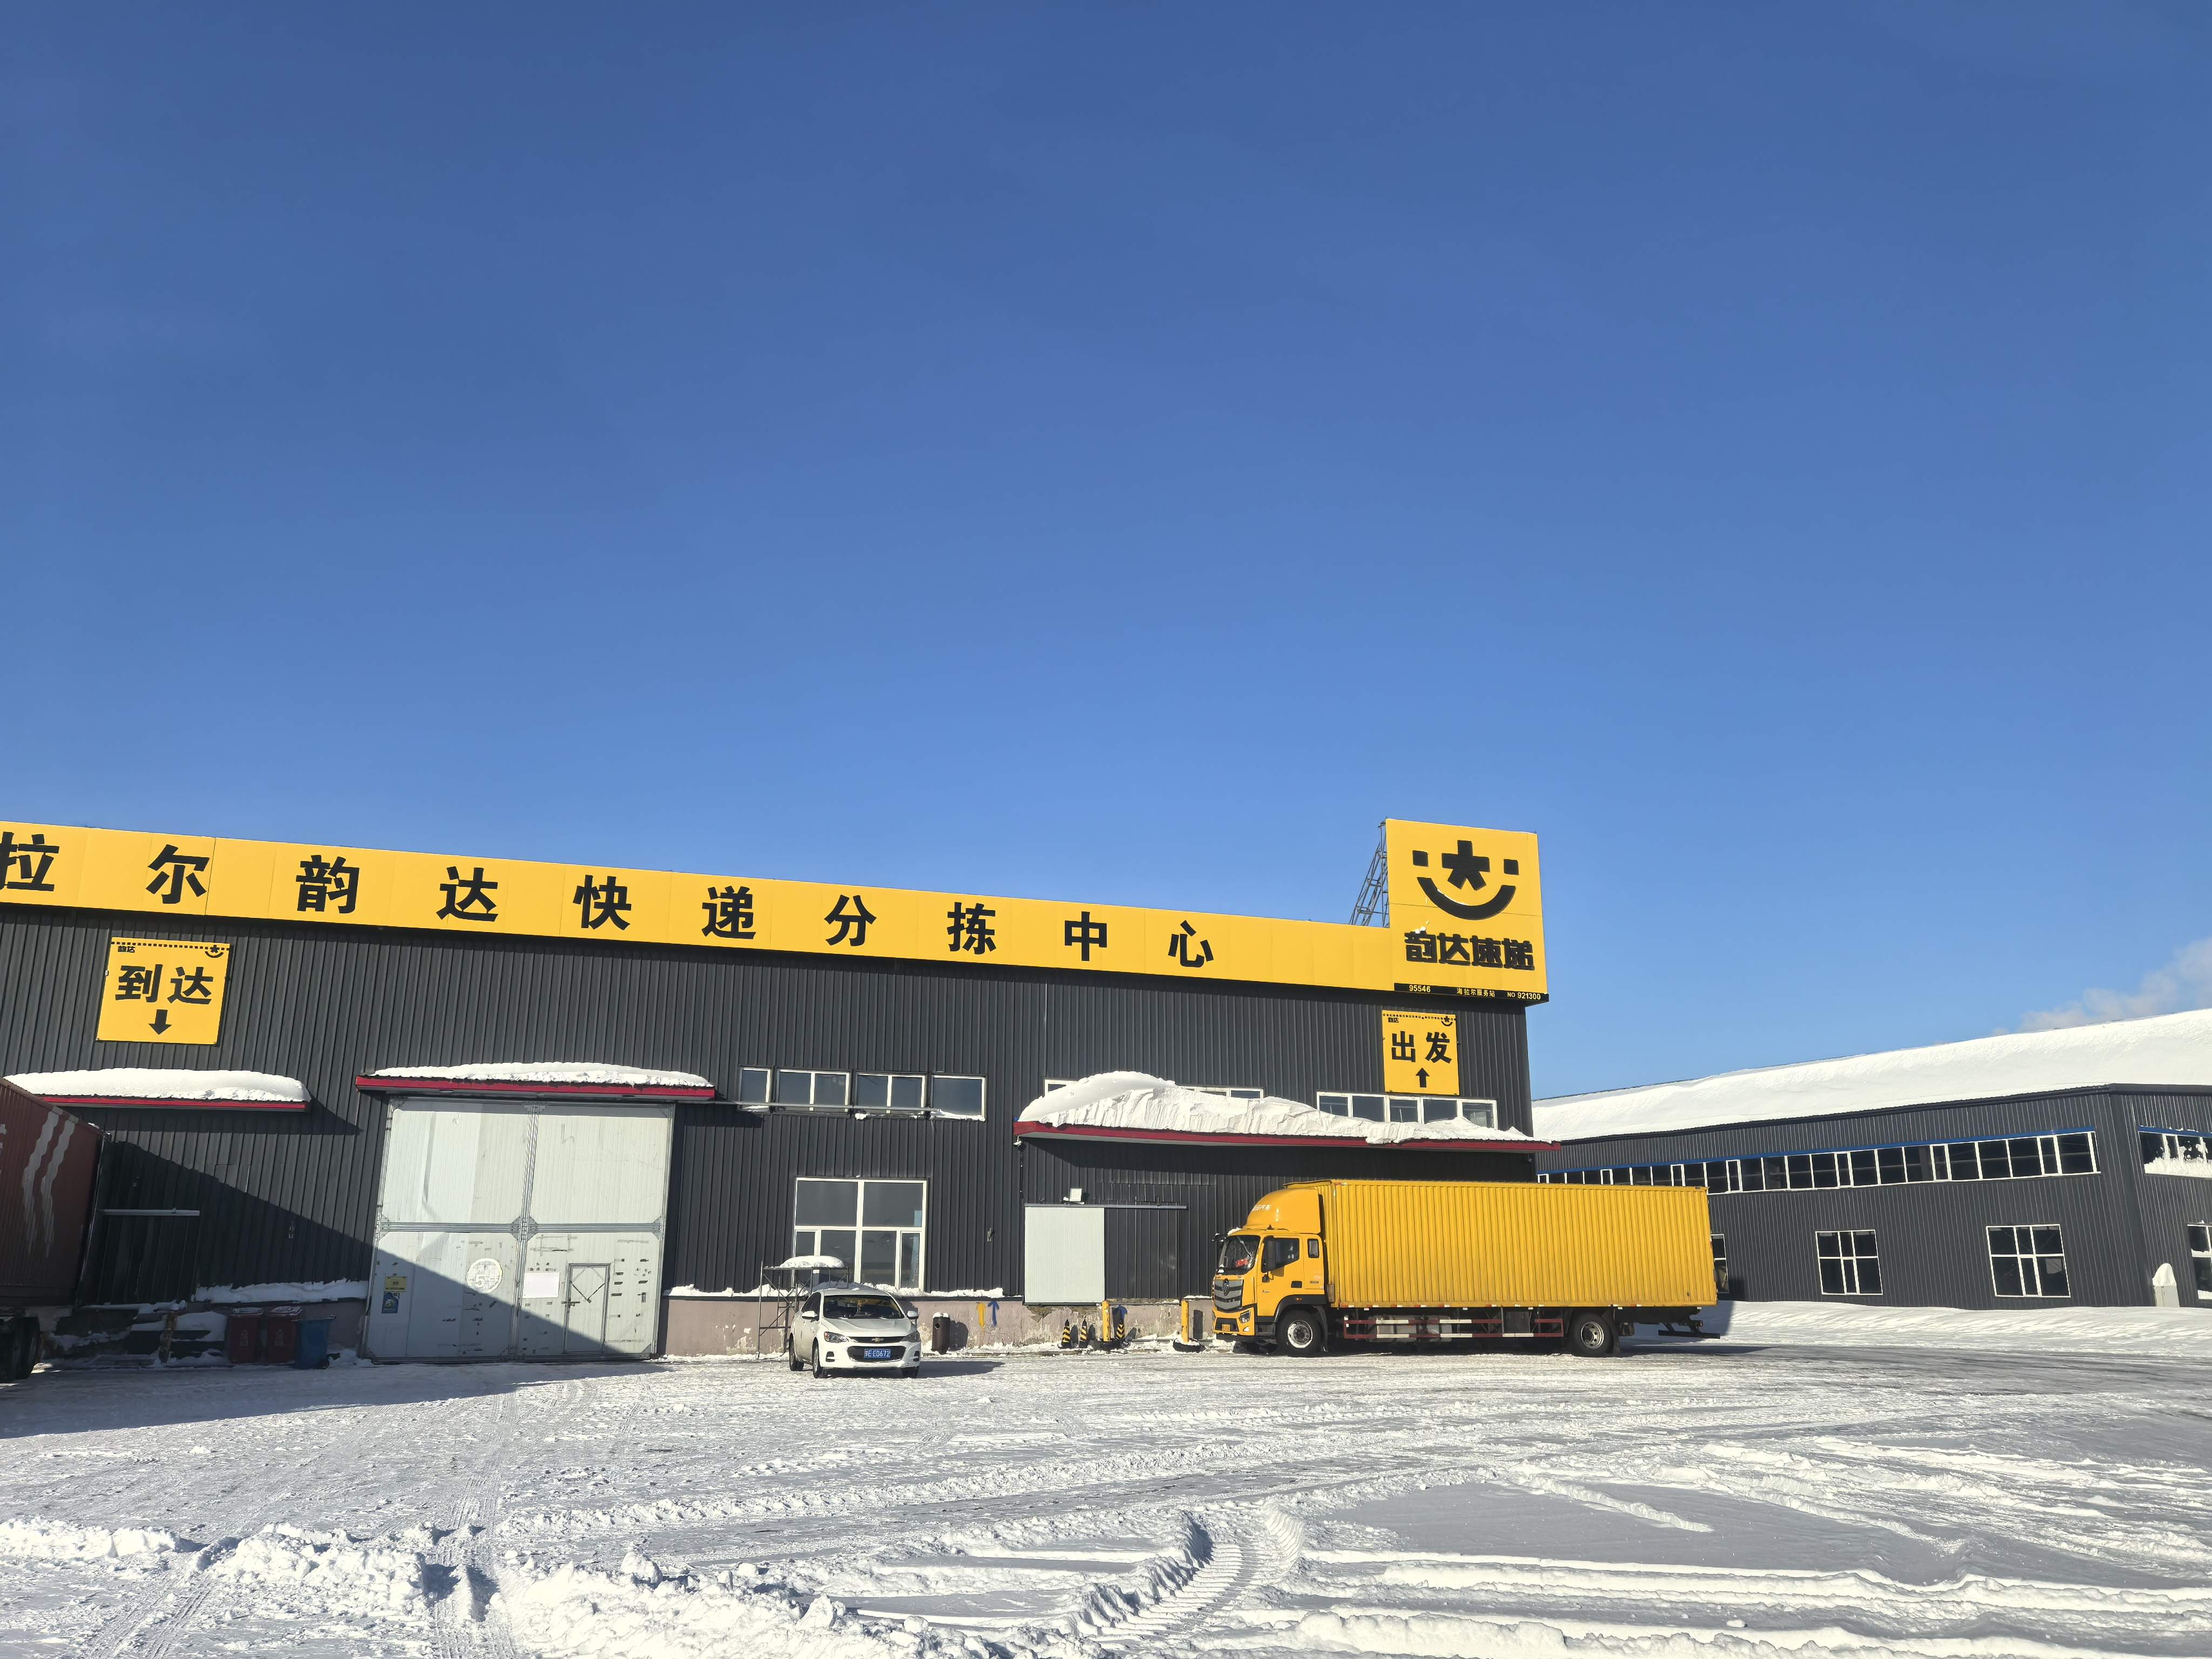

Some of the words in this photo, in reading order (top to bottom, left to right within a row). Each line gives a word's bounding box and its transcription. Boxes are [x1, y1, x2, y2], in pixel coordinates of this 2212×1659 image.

[1404, 930, 1535, 970] 韵达速递
[115, 964, 214, 1004] 到达
[1409, 984, 1431, 993] 95546
[1456, 988, 1495, 997] 海拉尔服务站
[1517, 992, 1541, 1000] 921300
[1392, 1030, 1452, 1064] 出发
